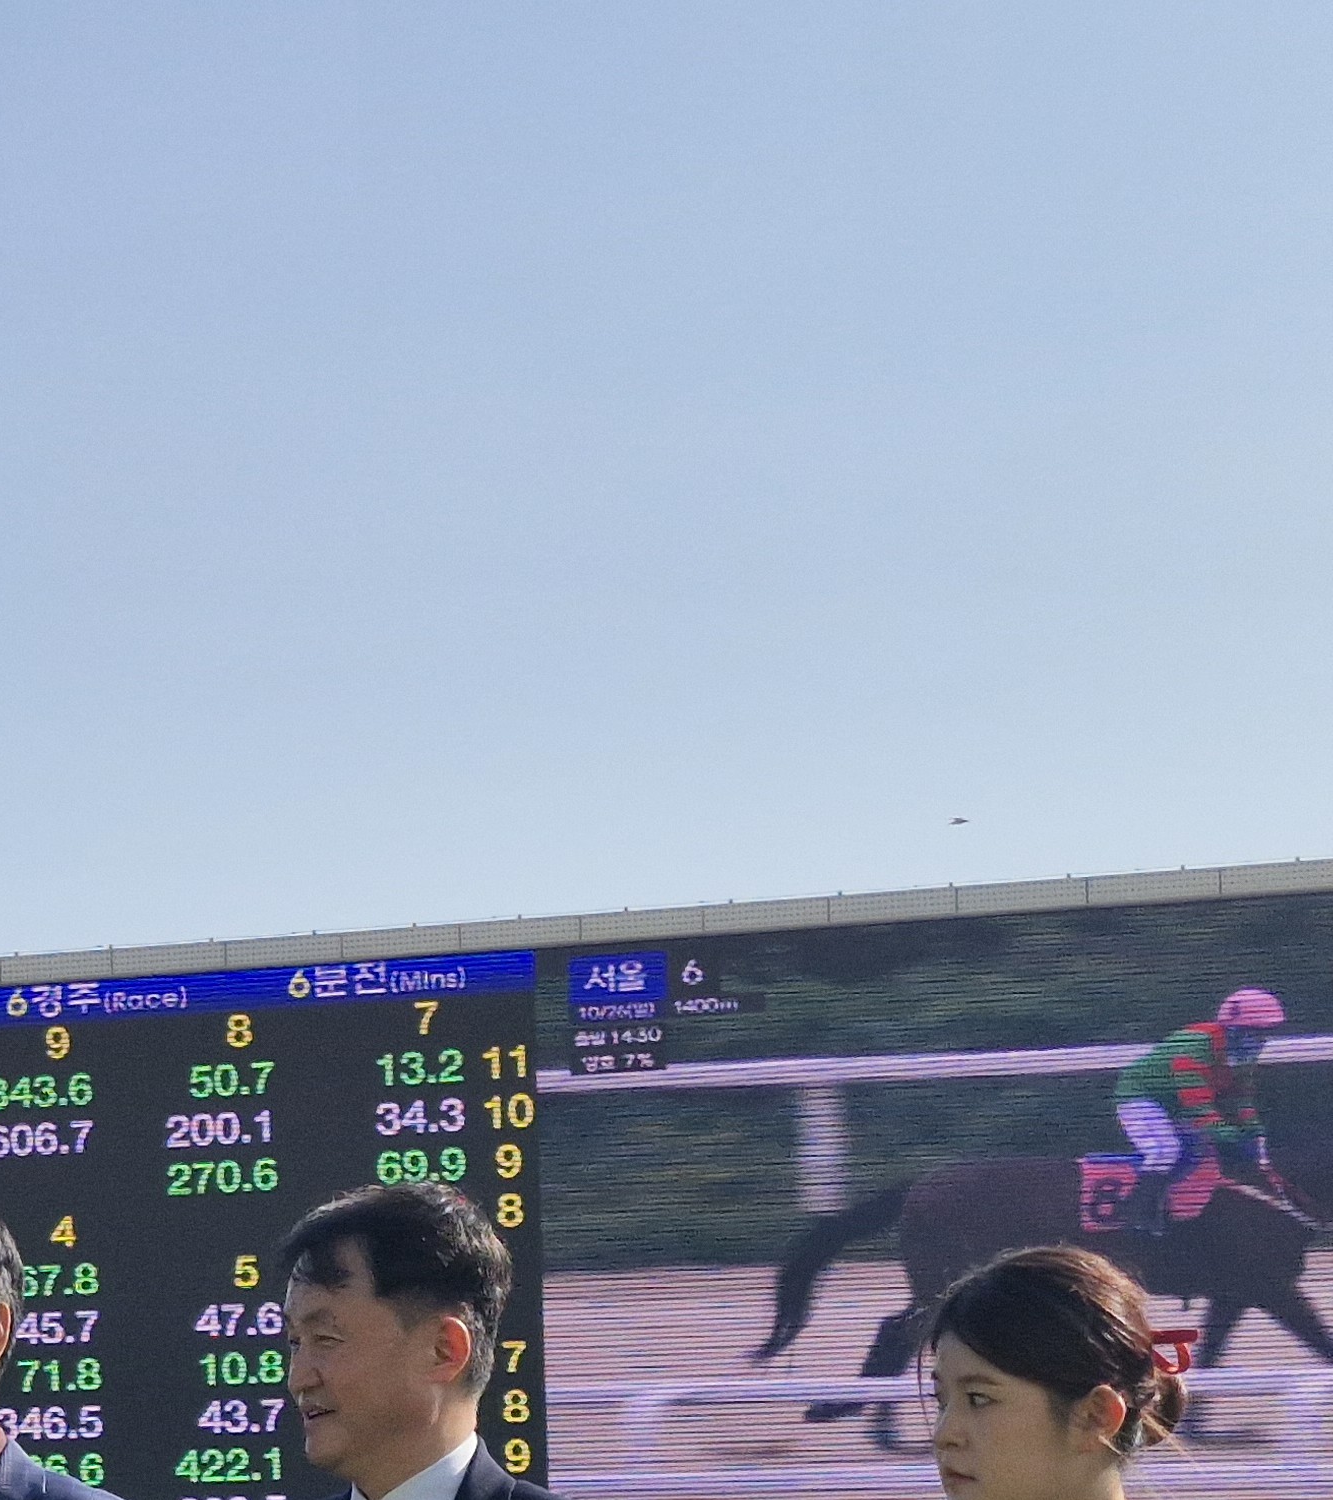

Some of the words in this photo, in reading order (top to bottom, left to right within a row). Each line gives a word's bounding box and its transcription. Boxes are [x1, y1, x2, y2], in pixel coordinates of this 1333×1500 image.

[584, 960, 647, 992] 서울
[682, 959, 704, 985] 6
[46, 1026, 70, 1059] 9
[227, 1014, 252, 1048] 8
[414, 1001, 438, 1034] 7
[190, 1062, 274, 1098] 50.7
[376, 1049, 464, 1086] 13.2
[483, 1045, 526, 1080] 11
[166, 1110, 270, 1147] 200.1
[376, 1098, 465, 1136] 34.3
[483, 1093, 533, 1129] 10
[167, 1158, 278, 1195] 270.6
[376, 1146, 467, 1184] 69.9
[495, 1144, 522, 1178] 9
[50, 1216, 76, 1247] 4
[497, 1193, 523, 1227] 8
[234, 1255, 259, 1288] 5
[15, 1310, 99, 1345] 45.7
[195, 1302, 283, 1337] 47.6
[17, 1358, 102, 1392] 71.8
[199, 1351, 285, 1385] 10.8
[502, 1341, 527, 1373] 7
[198, 1399, 284, 1433] 43.7
[503, 1389, 529, 1422] 8
[175, 1447, 281, 1483] 422.1
[504, 1439, 531, 1474] 9
